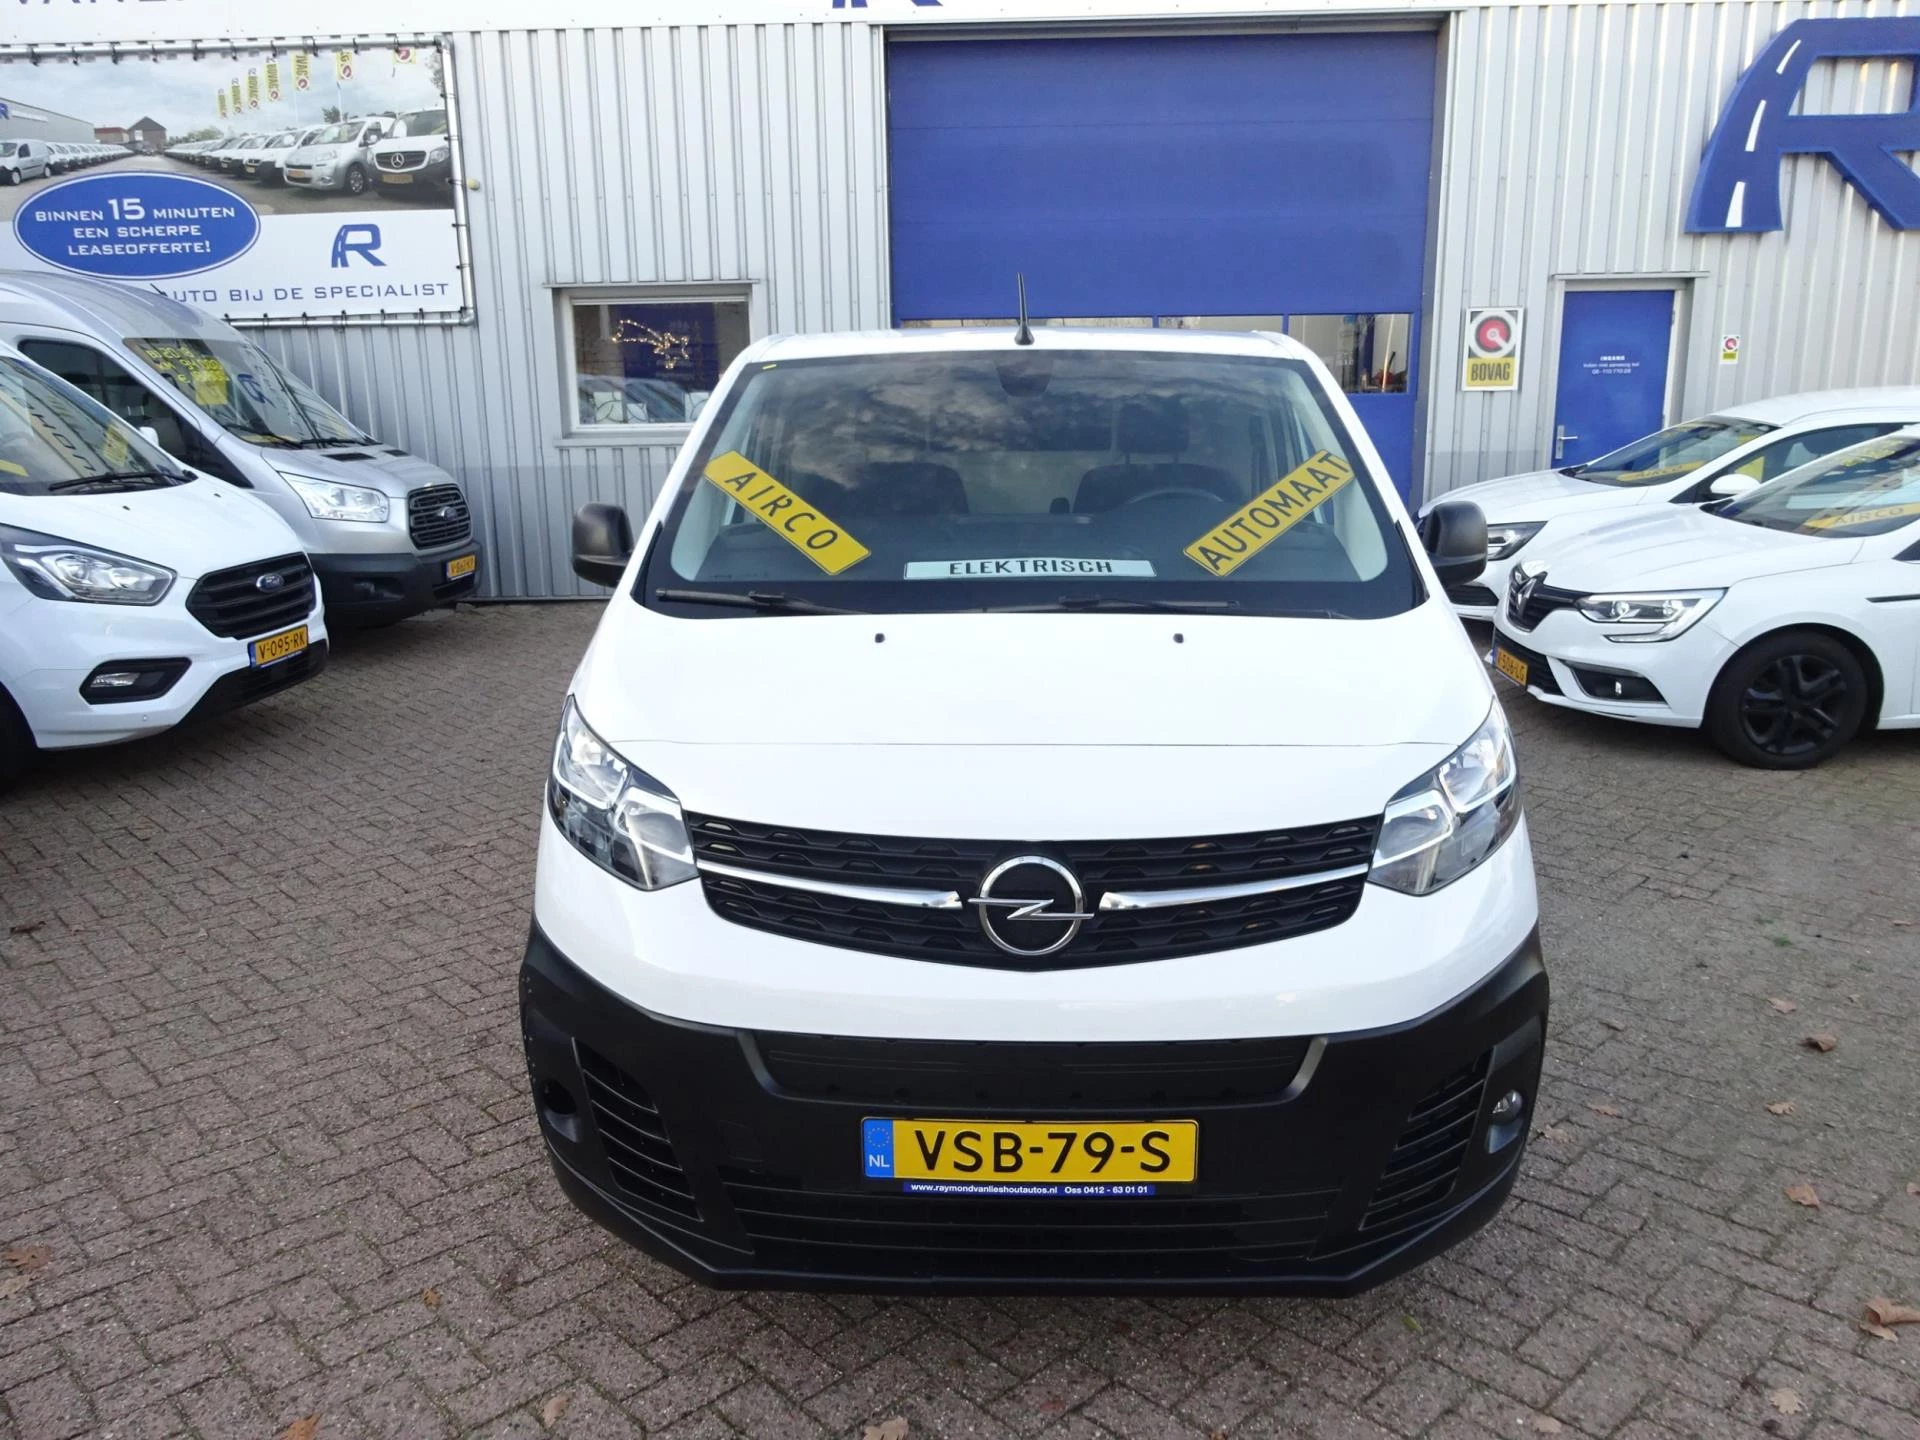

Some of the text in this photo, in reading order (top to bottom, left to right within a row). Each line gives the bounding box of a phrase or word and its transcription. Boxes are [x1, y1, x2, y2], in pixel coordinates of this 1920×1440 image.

[35, 198, 236, 222] BINNEN 15 MINUTEN
[73, 225, 202, 239] EEN SCHERPE
[68, 241, 211, 256] LEASEOFFERTE!
[165, 283, 449, 302] UTO BIJ DE SPECIALIST
[1471, 362, 1511, 381] BOVAG
[724, 471, 838, 549] AIRCO
[1198, 452, 1349, 571] AUTOMAAT
[1837, 506, 1903, 524] AIRCO
[949, 560, 1113, 575] ELEKTRISCH
[258, 630, 305, 660] V-095-RK
[868, 1155, 890, 1168] NL
[914, 1130, 1171, 1174] VSB-79-S
[911, 1184, 1058, 1195] www.raymondvanlieshoutautos.nl
[1064, 1186, 1082, 1194] Oss
[1083, 1186, 1105, 1194] 0412
[1112, 1186, 1123, 1194] 63
[1125, 1186, 1135, 1194] 01
[1137, 1186, 1148, 1194] 01
